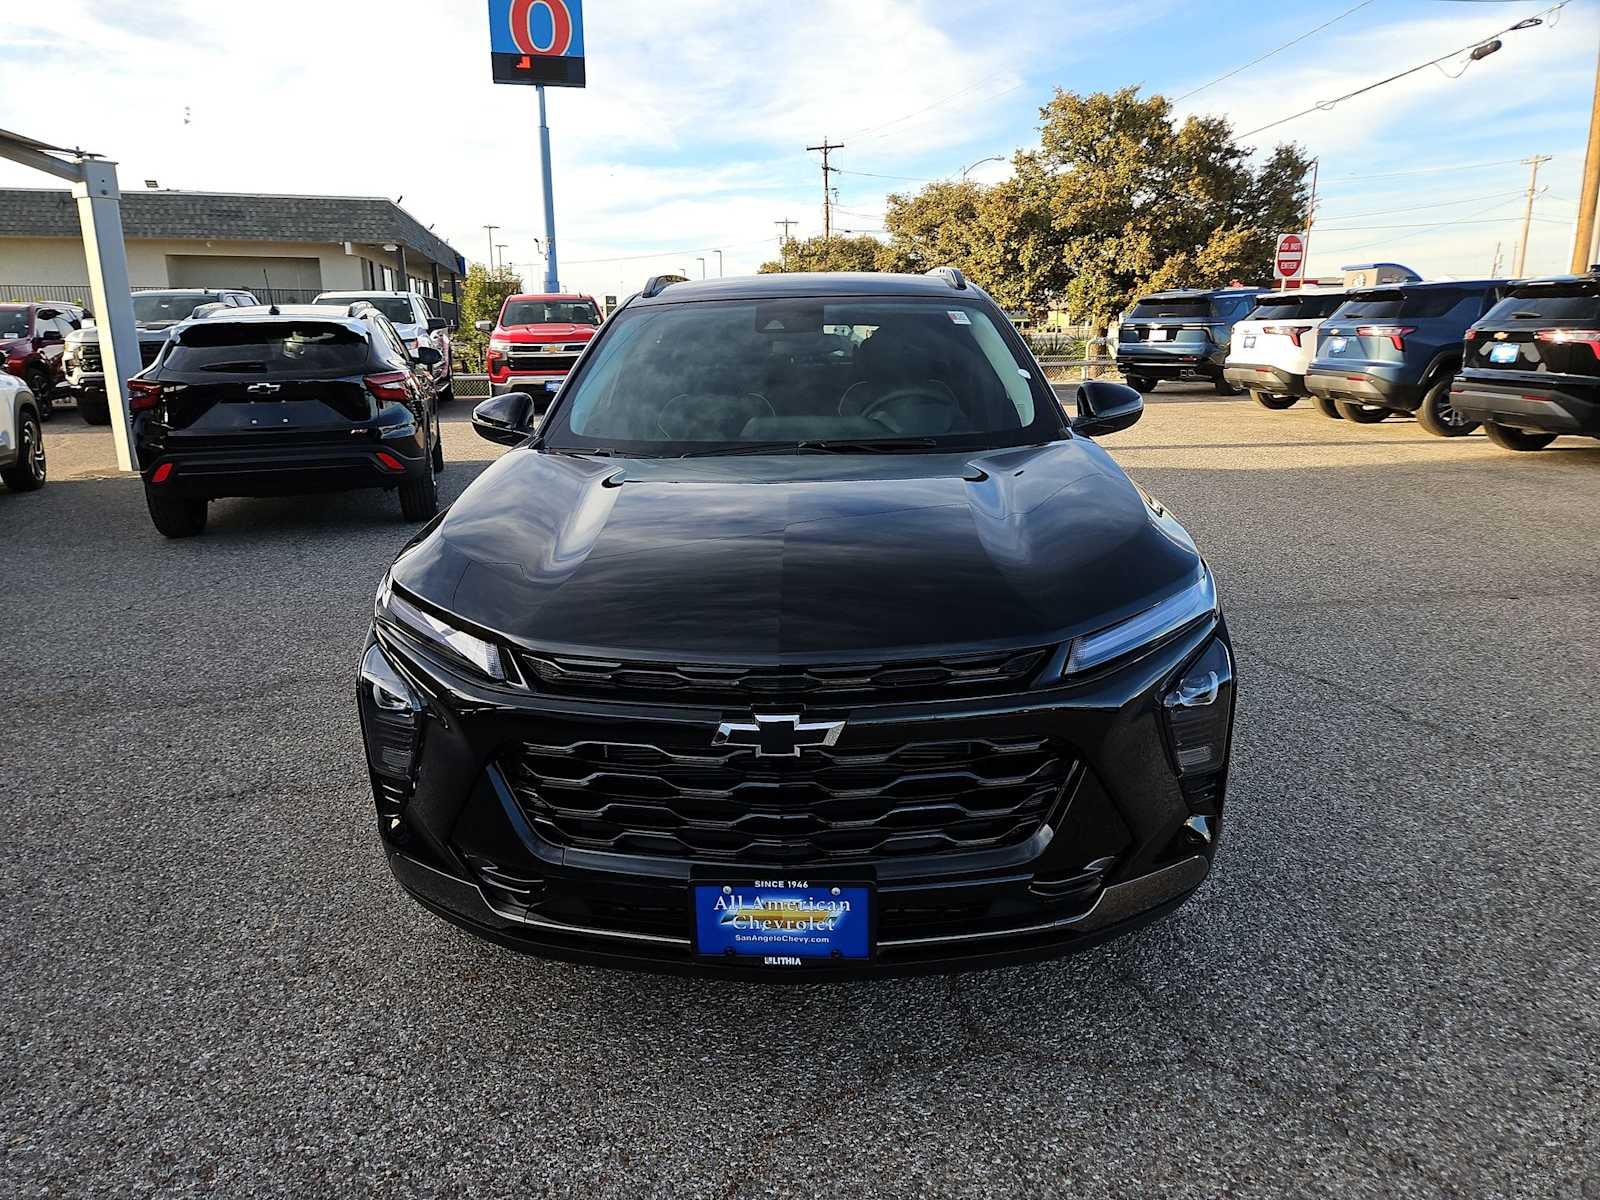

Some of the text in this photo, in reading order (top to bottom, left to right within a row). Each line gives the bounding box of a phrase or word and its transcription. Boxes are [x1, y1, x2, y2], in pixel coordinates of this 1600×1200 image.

[1280, 242, 1301, 250] DO NOT
[1280, 261, 1297, 269] ENTER
[754, 880, 809, 889] SINCE 1946
[713, 895, 851, 912] All American
[732, 915, 836, 932] Chevrolet
[735, 934, 829, 944] SanAngeloChevy.com
